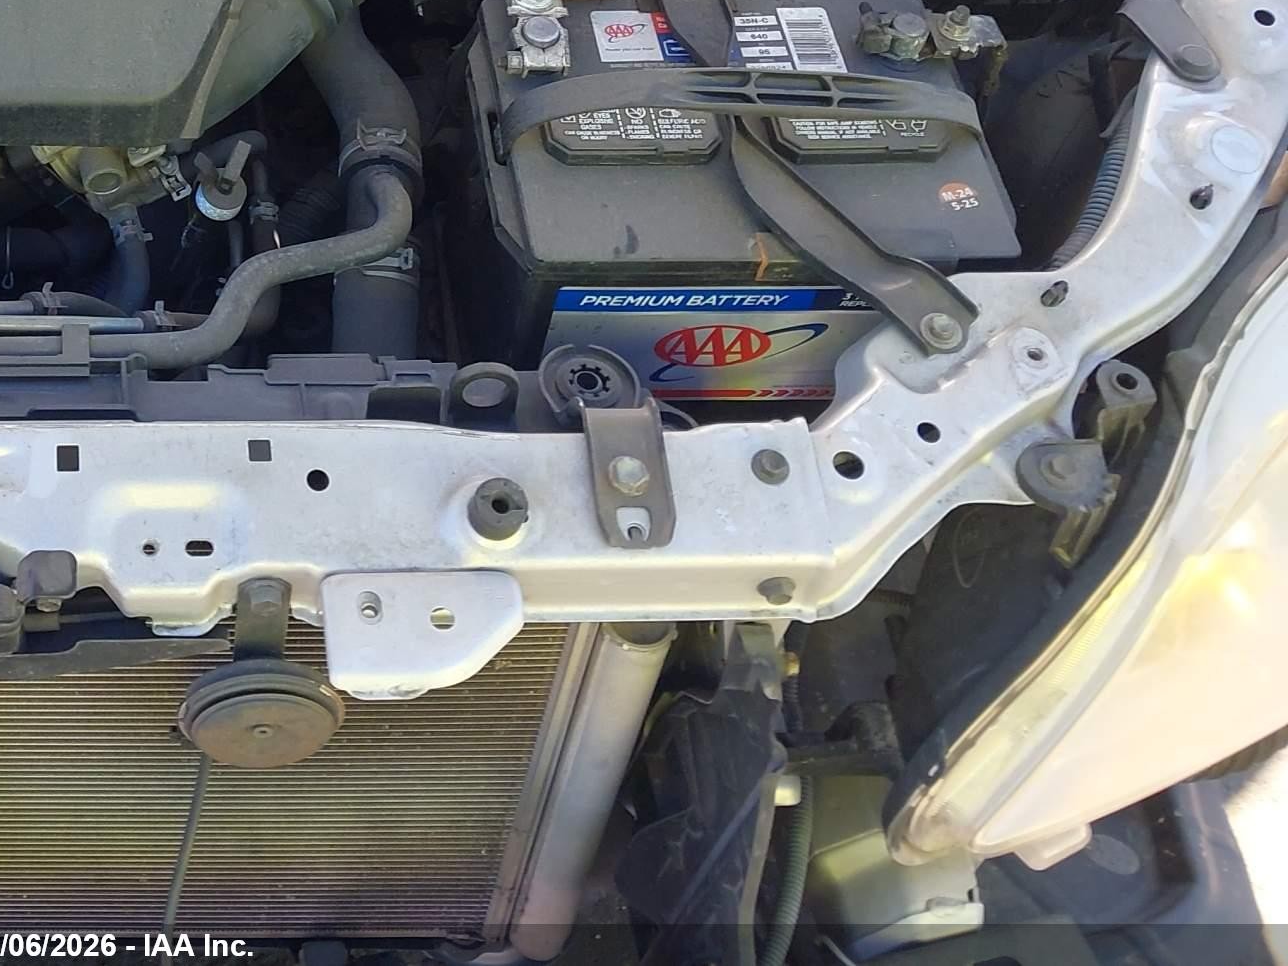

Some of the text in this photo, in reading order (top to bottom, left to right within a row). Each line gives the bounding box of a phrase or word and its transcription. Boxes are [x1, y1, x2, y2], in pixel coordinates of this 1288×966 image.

[606, 24, 633, 37] AAA
[579, 294, 790, 307] PREMIUM BATTERY
[661, 325, 762, 366] AAA
